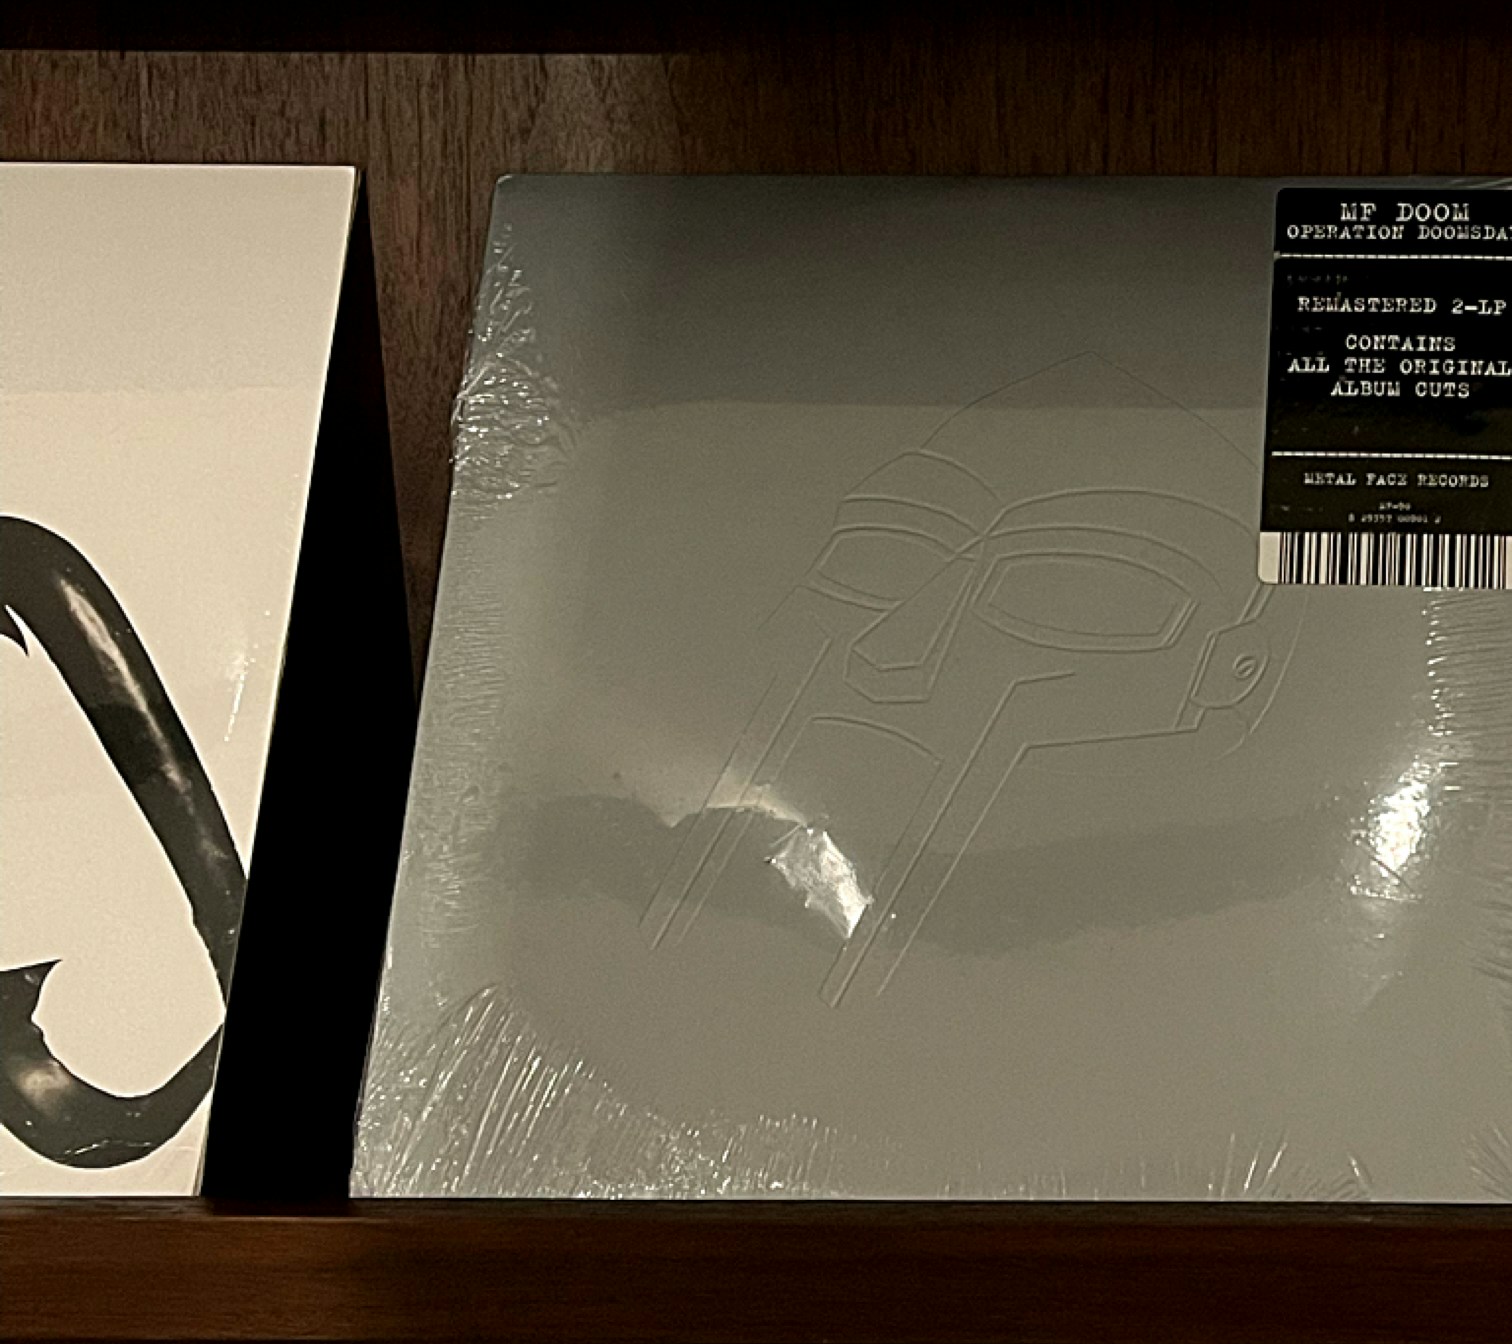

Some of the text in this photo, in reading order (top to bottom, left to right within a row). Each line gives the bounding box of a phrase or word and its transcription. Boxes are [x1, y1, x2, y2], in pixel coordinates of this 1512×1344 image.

[1339, 202, 1471, 224] MF DOOM
[1286, 223, 1404, 241] OPERATION
[1296, 295, 1508, 316] REMASTERED 2-LP
[1344, 333, 1457, 353] CONTAINS
[1286, 357, 1512, 377] ALL THE ORIGINAL
[1330, 380, 1471, 399] ALBUM CUTS
[1303, 472, 1490, 489] METAL FACE RECORDS
